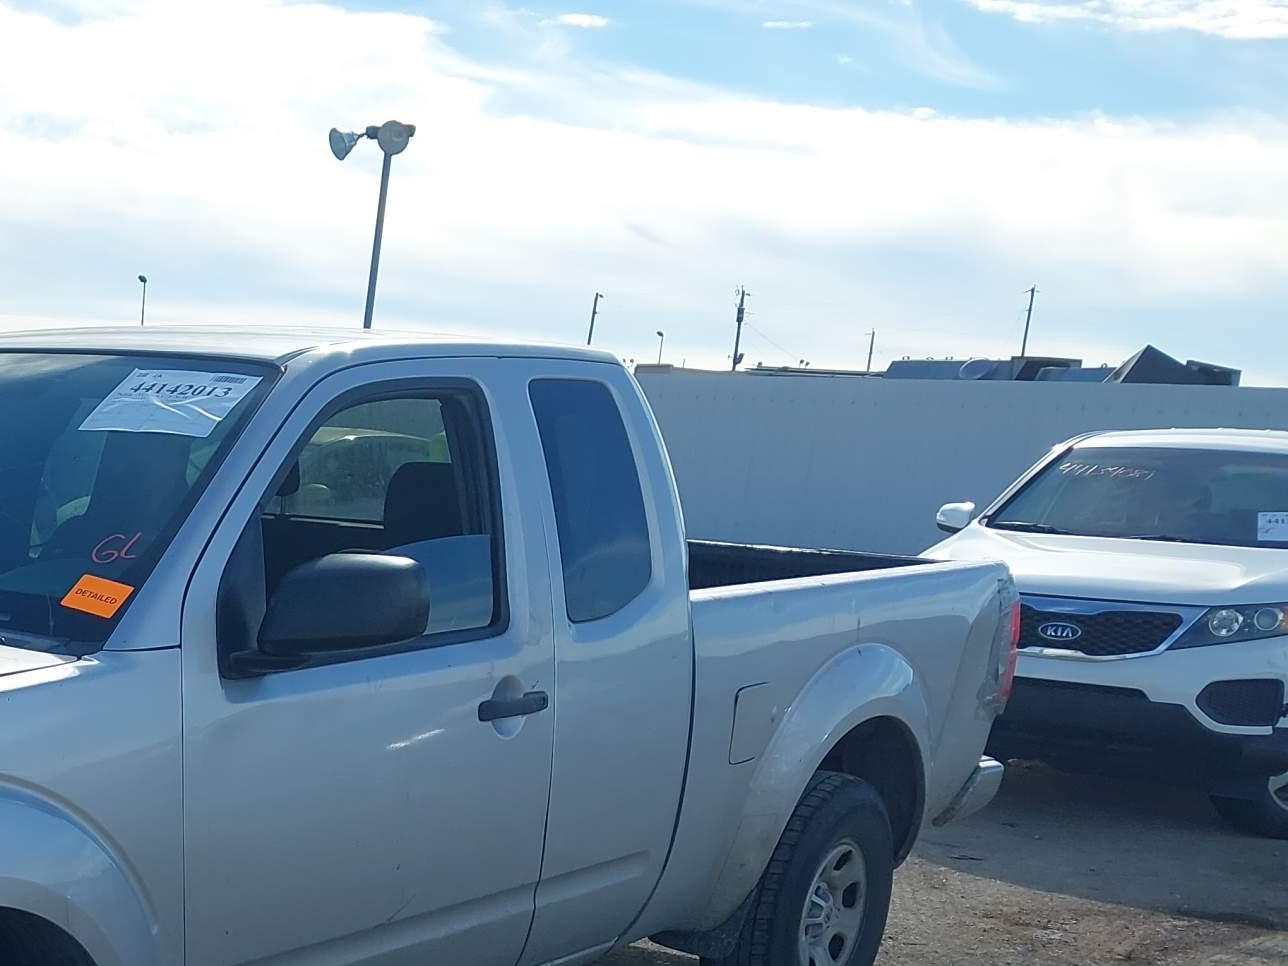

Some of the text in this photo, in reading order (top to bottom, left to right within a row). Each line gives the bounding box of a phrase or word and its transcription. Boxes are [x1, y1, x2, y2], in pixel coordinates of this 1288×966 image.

[129, 381, 233, 398] 44142013
[74, 588, 118, 605] DETAILED
[1046, 626, 1073, 637] KIA
